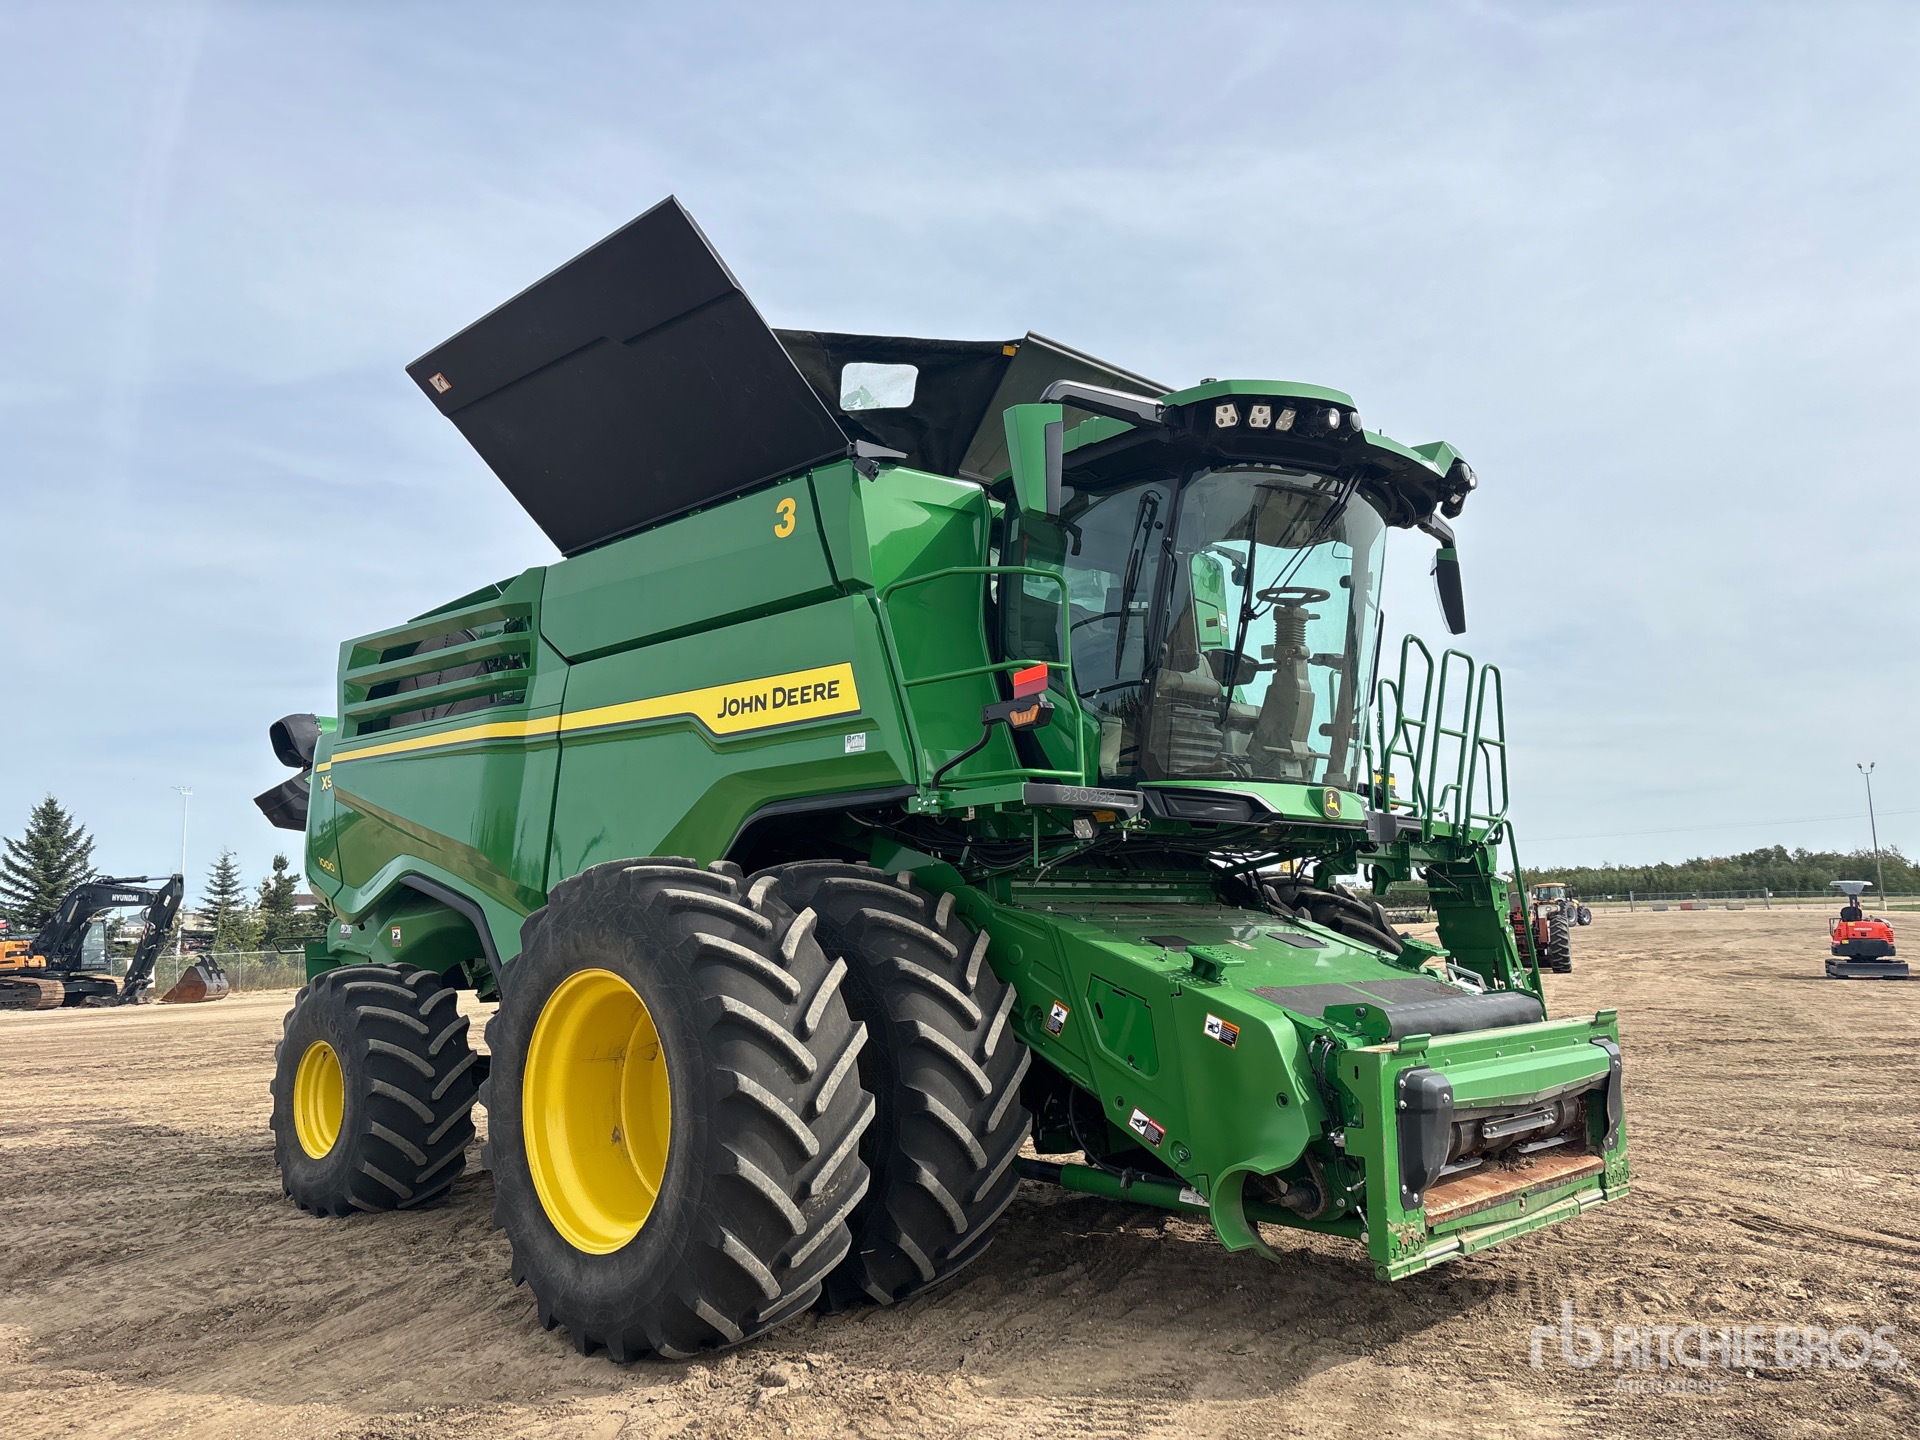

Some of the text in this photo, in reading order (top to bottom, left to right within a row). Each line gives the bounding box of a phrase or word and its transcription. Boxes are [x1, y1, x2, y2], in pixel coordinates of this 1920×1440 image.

[774, 497, 796, 538] 3
[717, 680, 840, 718] JOHN DEERE
[318, 856, 336, 873] 1000
[111, 893, 140, 902] HYUNDAI
